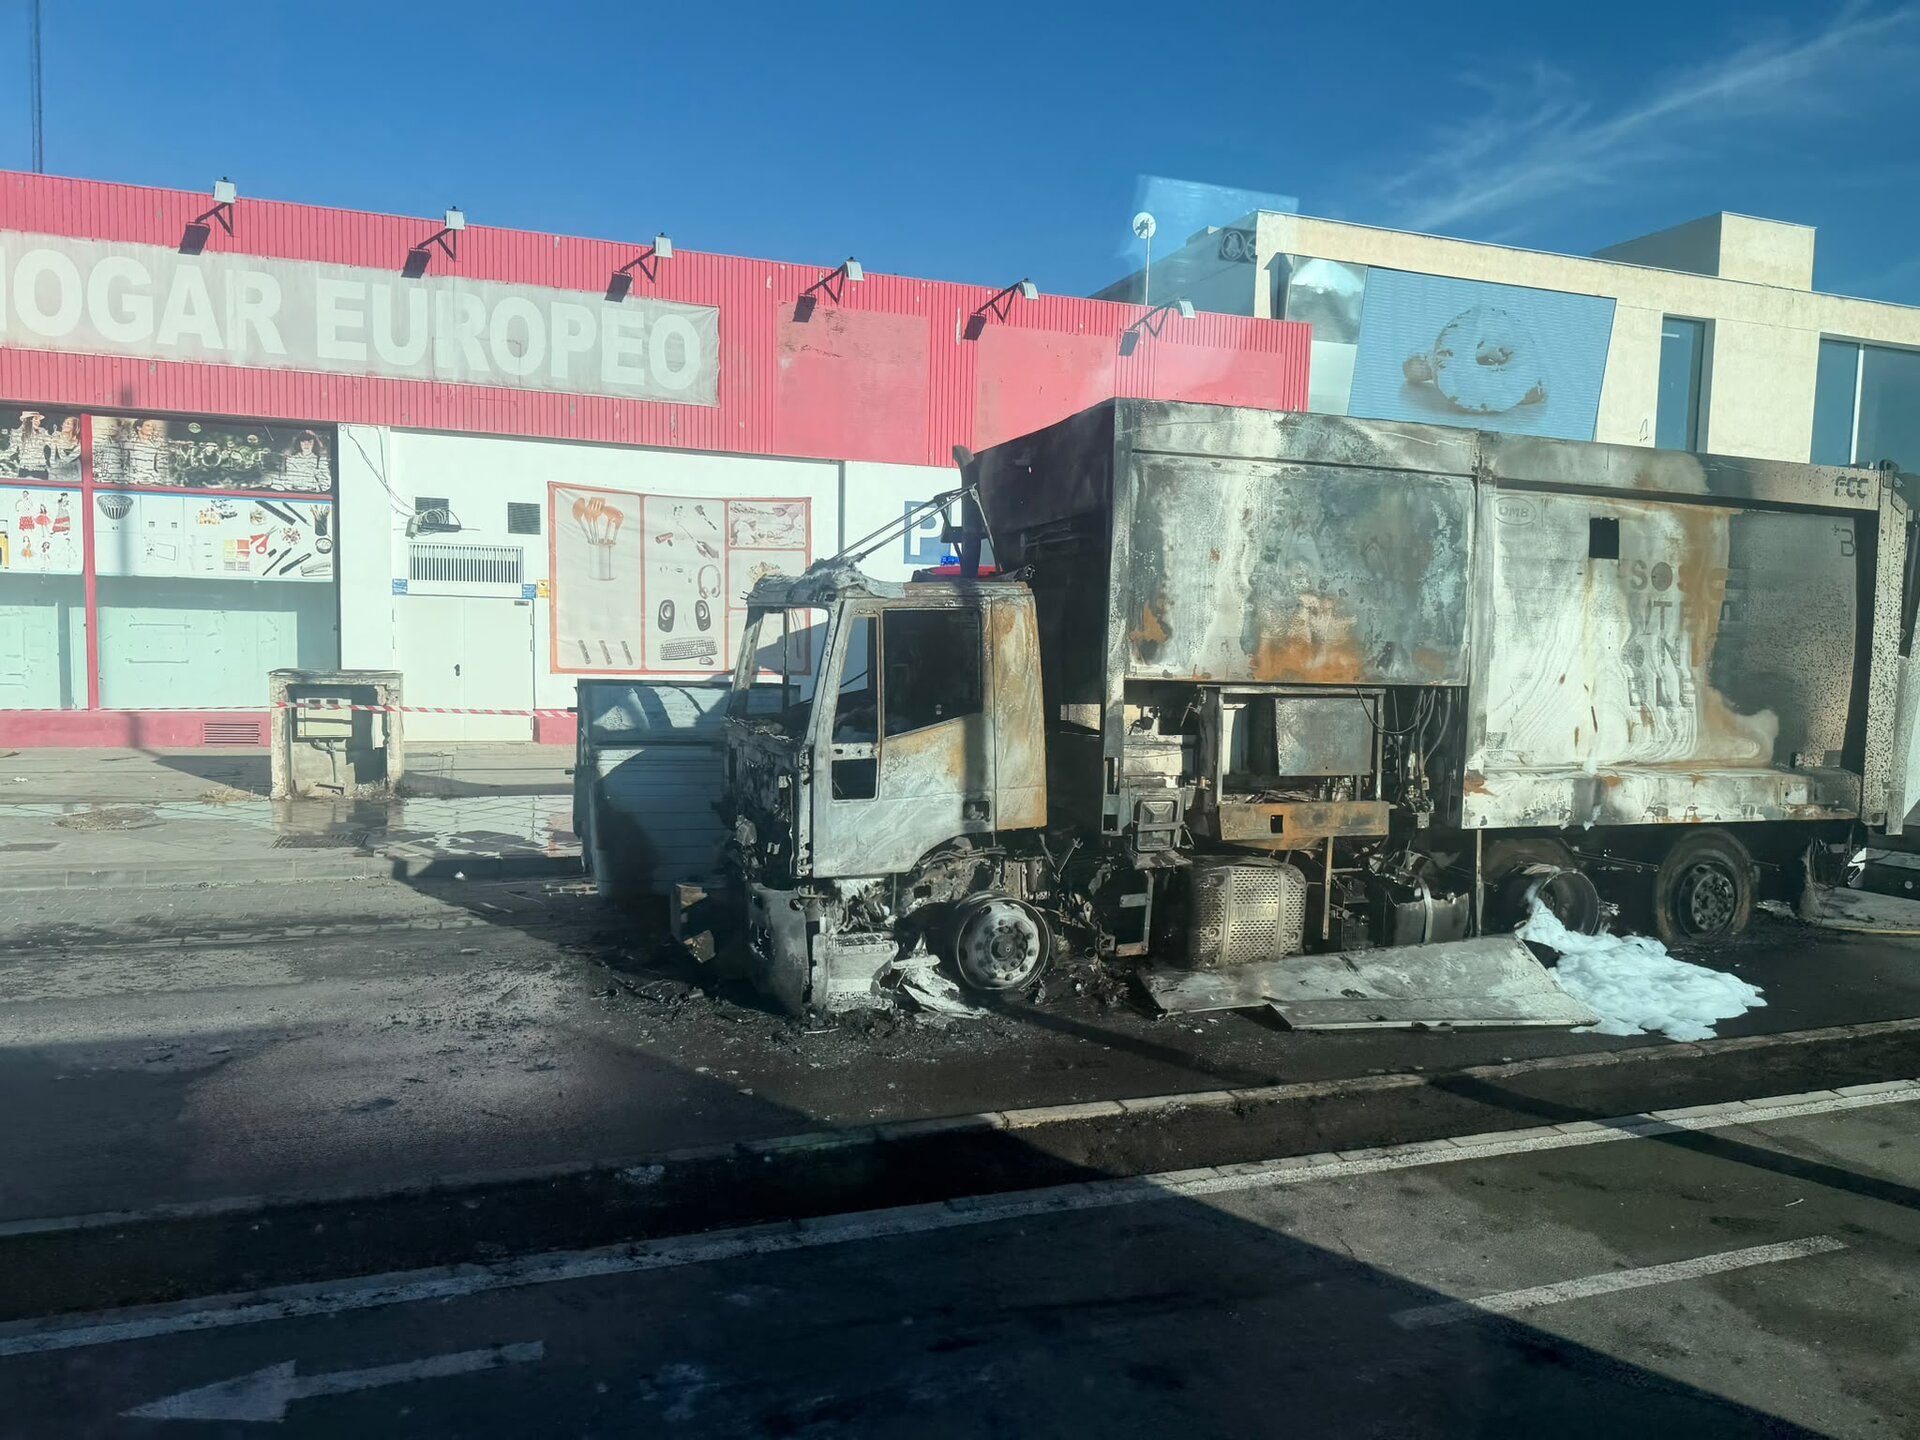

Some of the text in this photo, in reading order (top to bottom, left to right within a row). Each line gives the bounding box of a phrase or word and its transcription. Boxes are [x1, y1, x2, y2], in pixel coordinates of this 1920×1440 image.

[0, 246, 702, 391] OGAR EUROPEO
[1834, 475, 1869, 498] FCC
[910, 505, 945, 556] P
